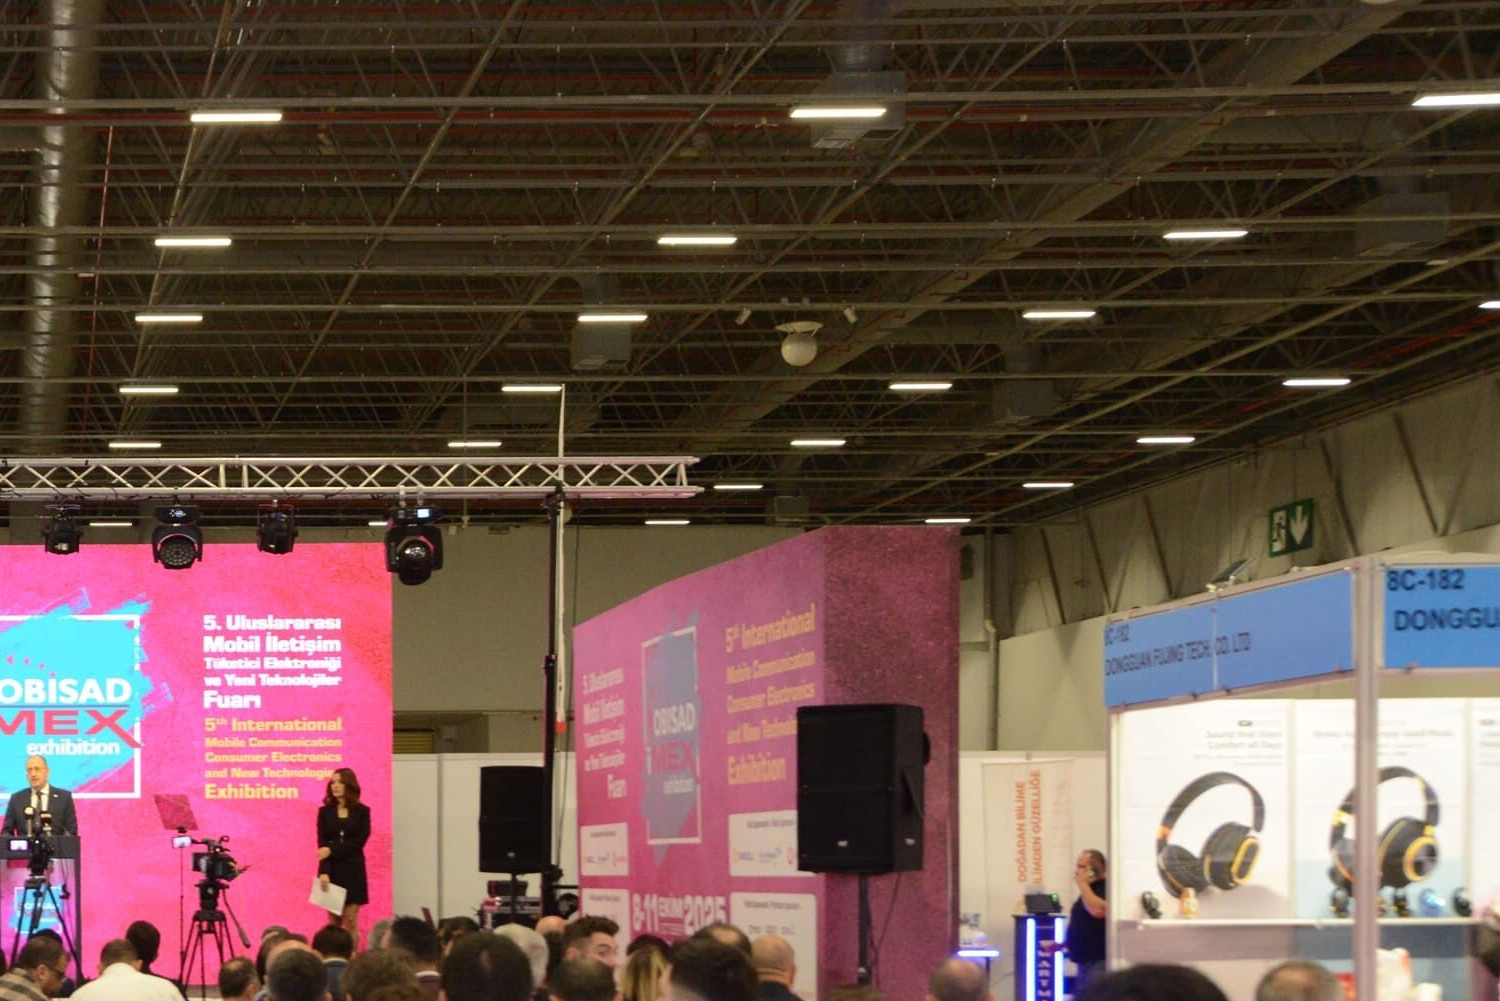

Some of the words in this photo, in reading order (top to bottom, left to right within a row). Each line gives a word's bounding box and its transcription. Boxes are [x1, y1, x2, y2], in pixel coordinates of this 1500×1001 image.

[1387, 569, 1465, 591] 8C-182
[203, 614, 222, 630] 5.
[203, 635, 260, 652] Mobil
[231, 717, 342, 732] International
[26, 738, 121, 756] exhibition
[204, 783, 299, 800] Exhibition
[1031, 836, 1043, 885] İLİMDEN
